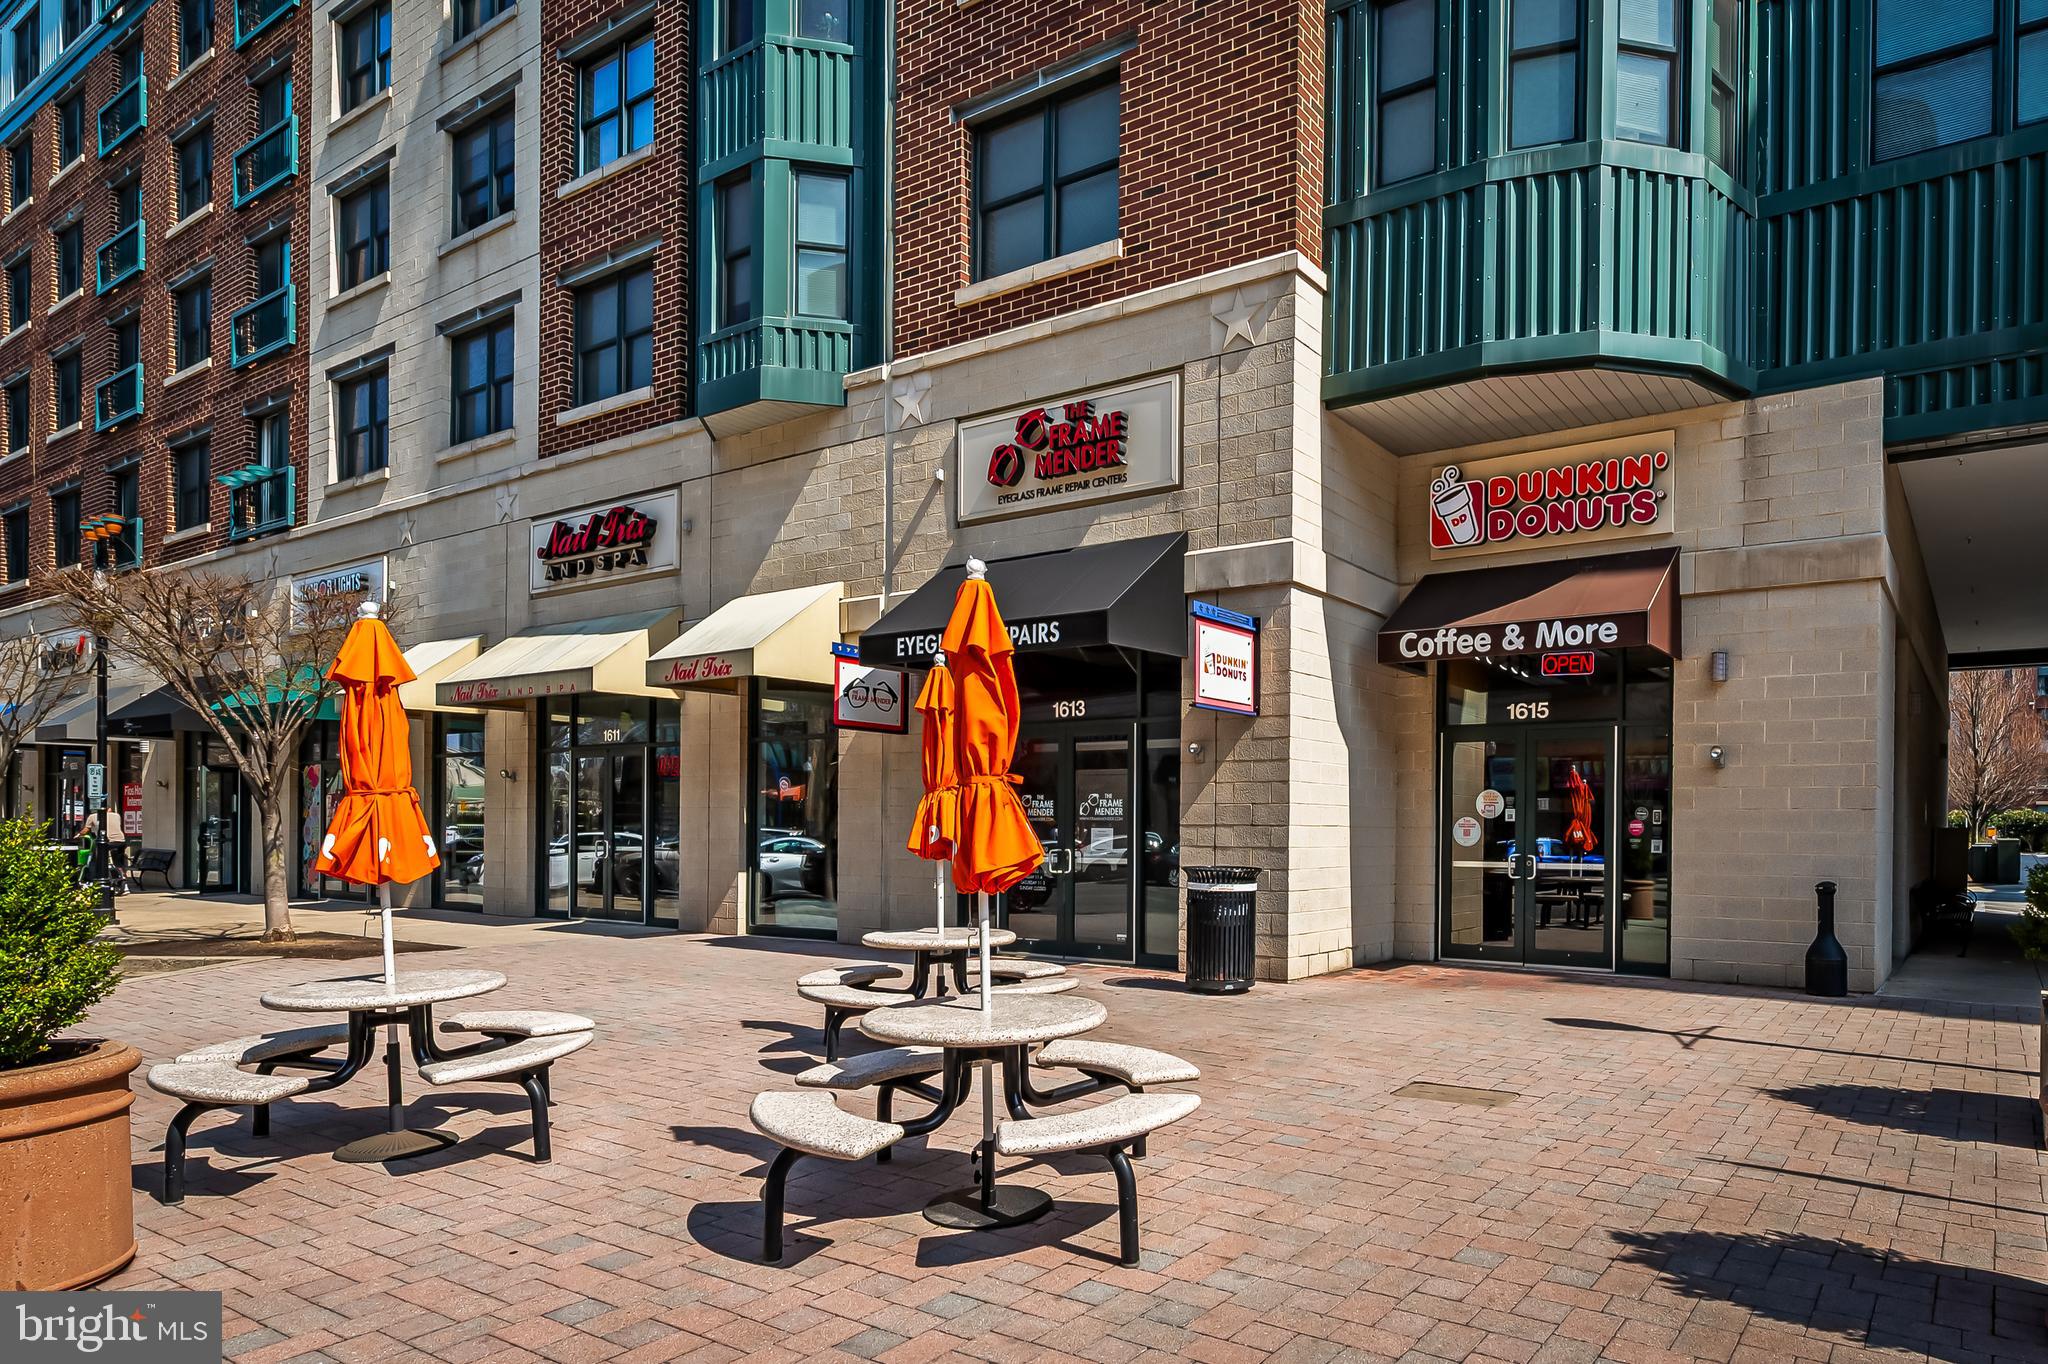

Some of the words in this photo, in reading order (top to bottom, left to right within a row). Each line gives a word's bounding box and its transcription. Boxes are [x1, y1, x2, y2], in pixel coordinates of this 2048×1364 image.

[1062, 400, 1090, 422] THE
[1049, 410, 1124, 450] FRAME
[1033, 438, 1122, 479] MENDER
[997, 489, 1036, 505] EYEGLASS
[1036, 484, 1064, 498] FRAME
[1064, 479, 1091, 494] REPAIR
[1092, 472, 1128, 489] CENTERS
[1488, 451, 1669, 508] DUNKIN'
[1487, 489, 1658, 542] DONUTS
[536, 512, 602, 560] Nail
[597, 505, 658, 547] Trix
[544, 559, 588, 580] AND
[596, 548, 640, 571] SPA
[896, 633, 945, 657] EYEGL
[1006, 621, 1060, 646] PAIRS
[1399, 627, 1491, 659] Coffee
[1502, 624, 1525, 650] &
[1535, 620, 1618, 649] More
[665, 659, 698, 682] Nail
[701, 655, 733, 677] Trix
[1216, 666, 1247, 682] DONUTS
[1543, 655, 1593, 674] OPEN
[450, 683, 474, 702] Nail
[476, 682, 499, 700] Trix
[507, 686, 534, 697] AND
[870, 695, 891, 705] MNDER
[1052, 699, 1086, 718] 1613
[1507, 701, 1550, 720] 1615
[603, 728, 621, 743] 1611
[1027, 808, 1055, 817] MENDER
[1031, 799, 1054, 809] FRAME
[1094, 807, 1123, 816] MENDER
[1099, 798, 1123, 808] FRAME
